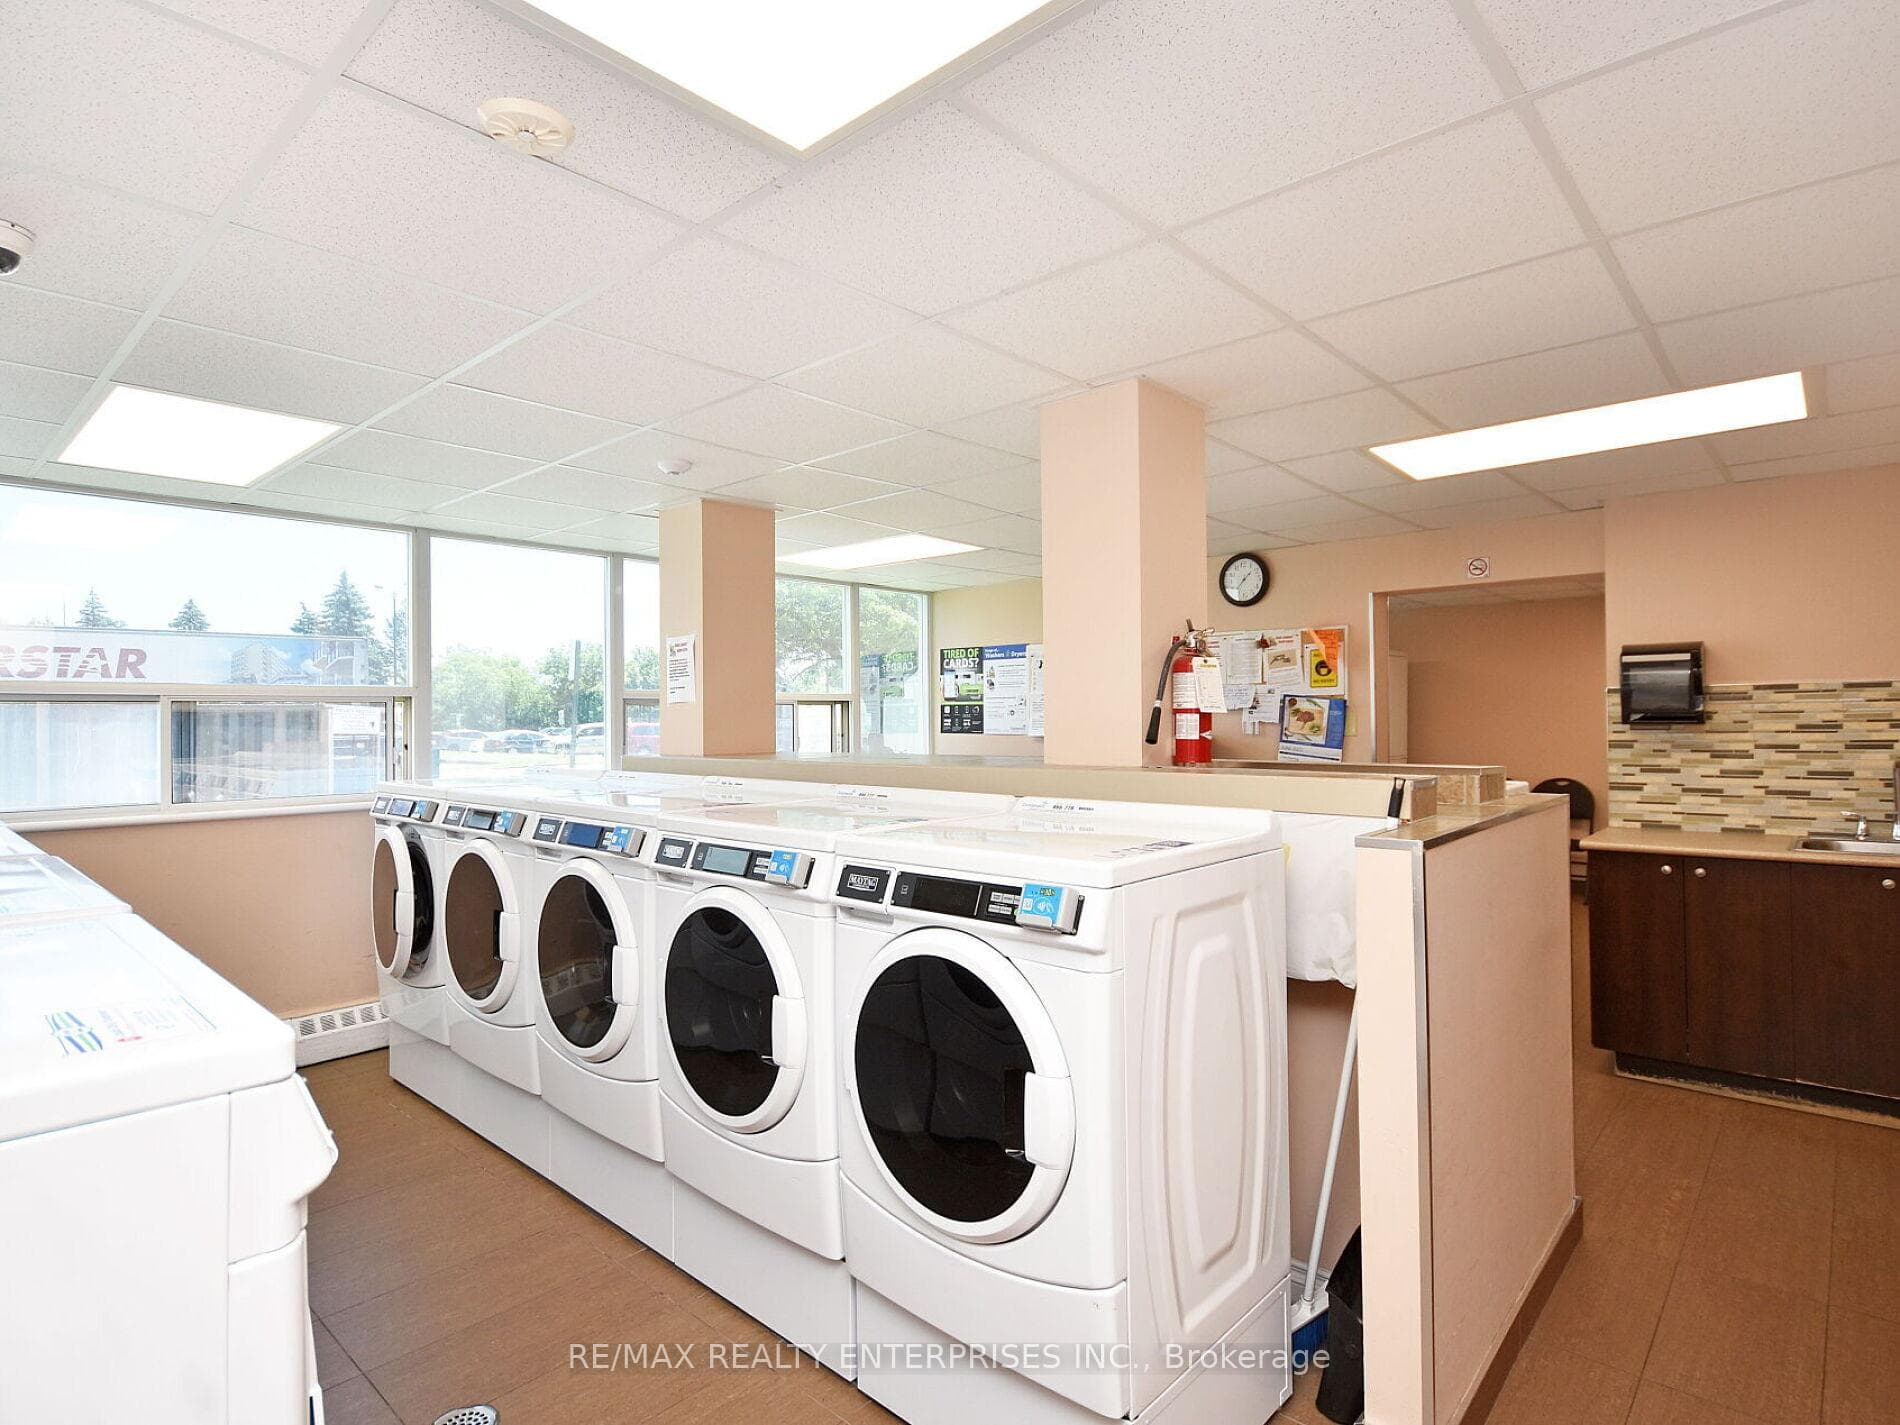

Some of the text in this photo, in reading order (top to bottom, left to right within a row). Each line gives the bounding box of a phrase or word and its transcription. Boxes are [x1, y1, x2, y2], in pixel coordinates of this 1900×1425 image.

[943, 648, 966, 659] TIRED
[967, 647, 979, 658] OF
[943, 657, 979, 668] CARDS?
